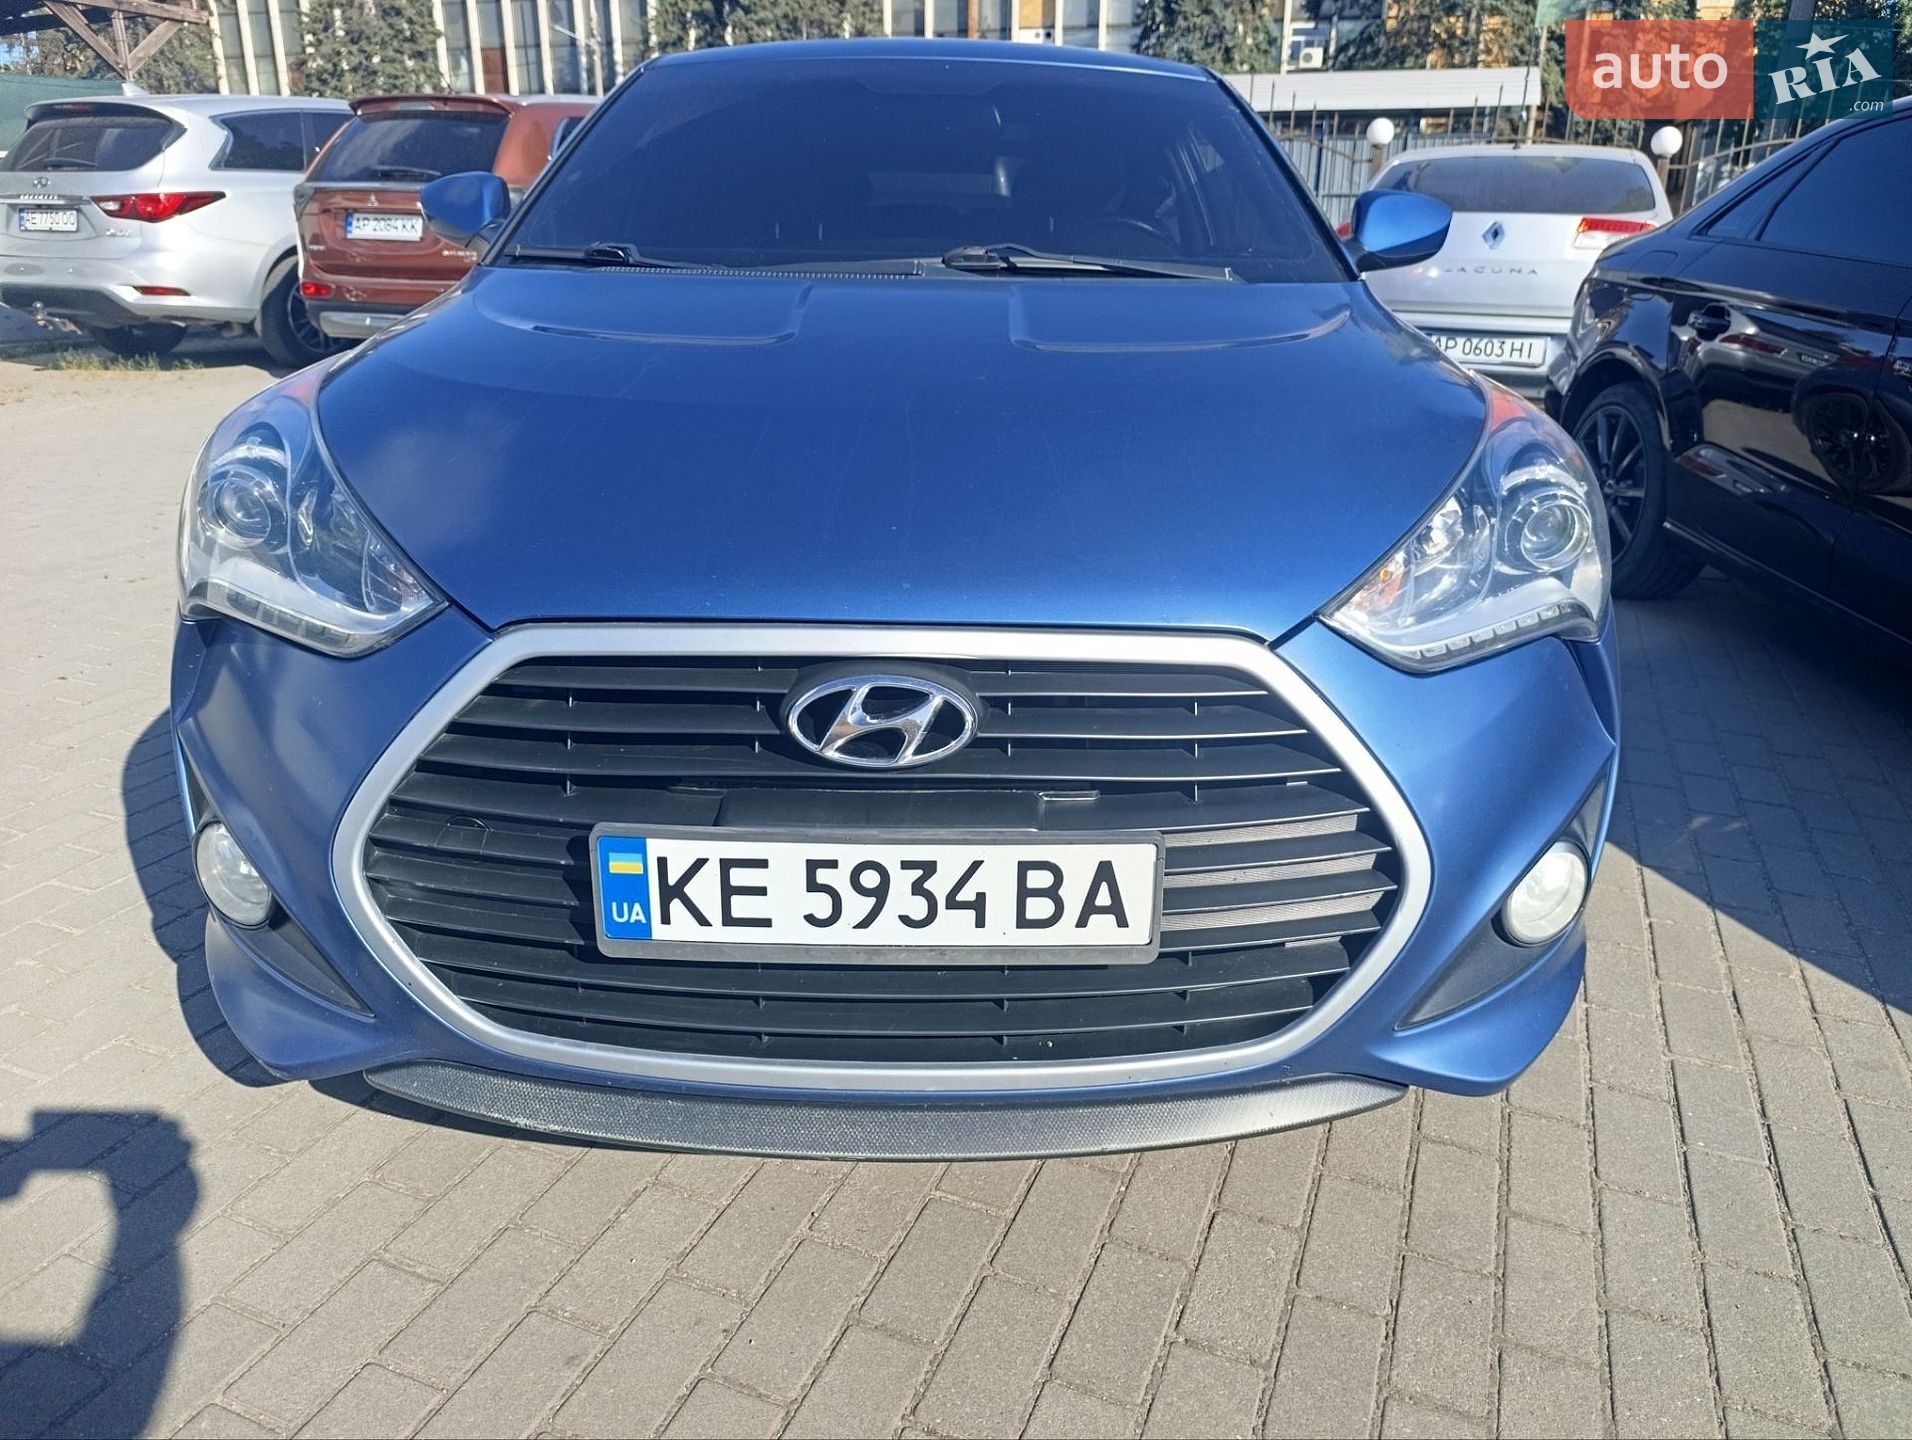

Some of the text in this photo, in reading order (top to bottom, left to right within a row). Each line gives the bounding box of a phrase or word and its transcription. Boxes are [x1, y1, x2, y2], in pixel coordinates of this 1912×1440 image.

[1462, 338, 1506, 358] 0603
[1509, 342, 1534, 359] HI
[656, 856, 1129, 929] KE 5934 BA
[612, 901, 647, 924] UA
